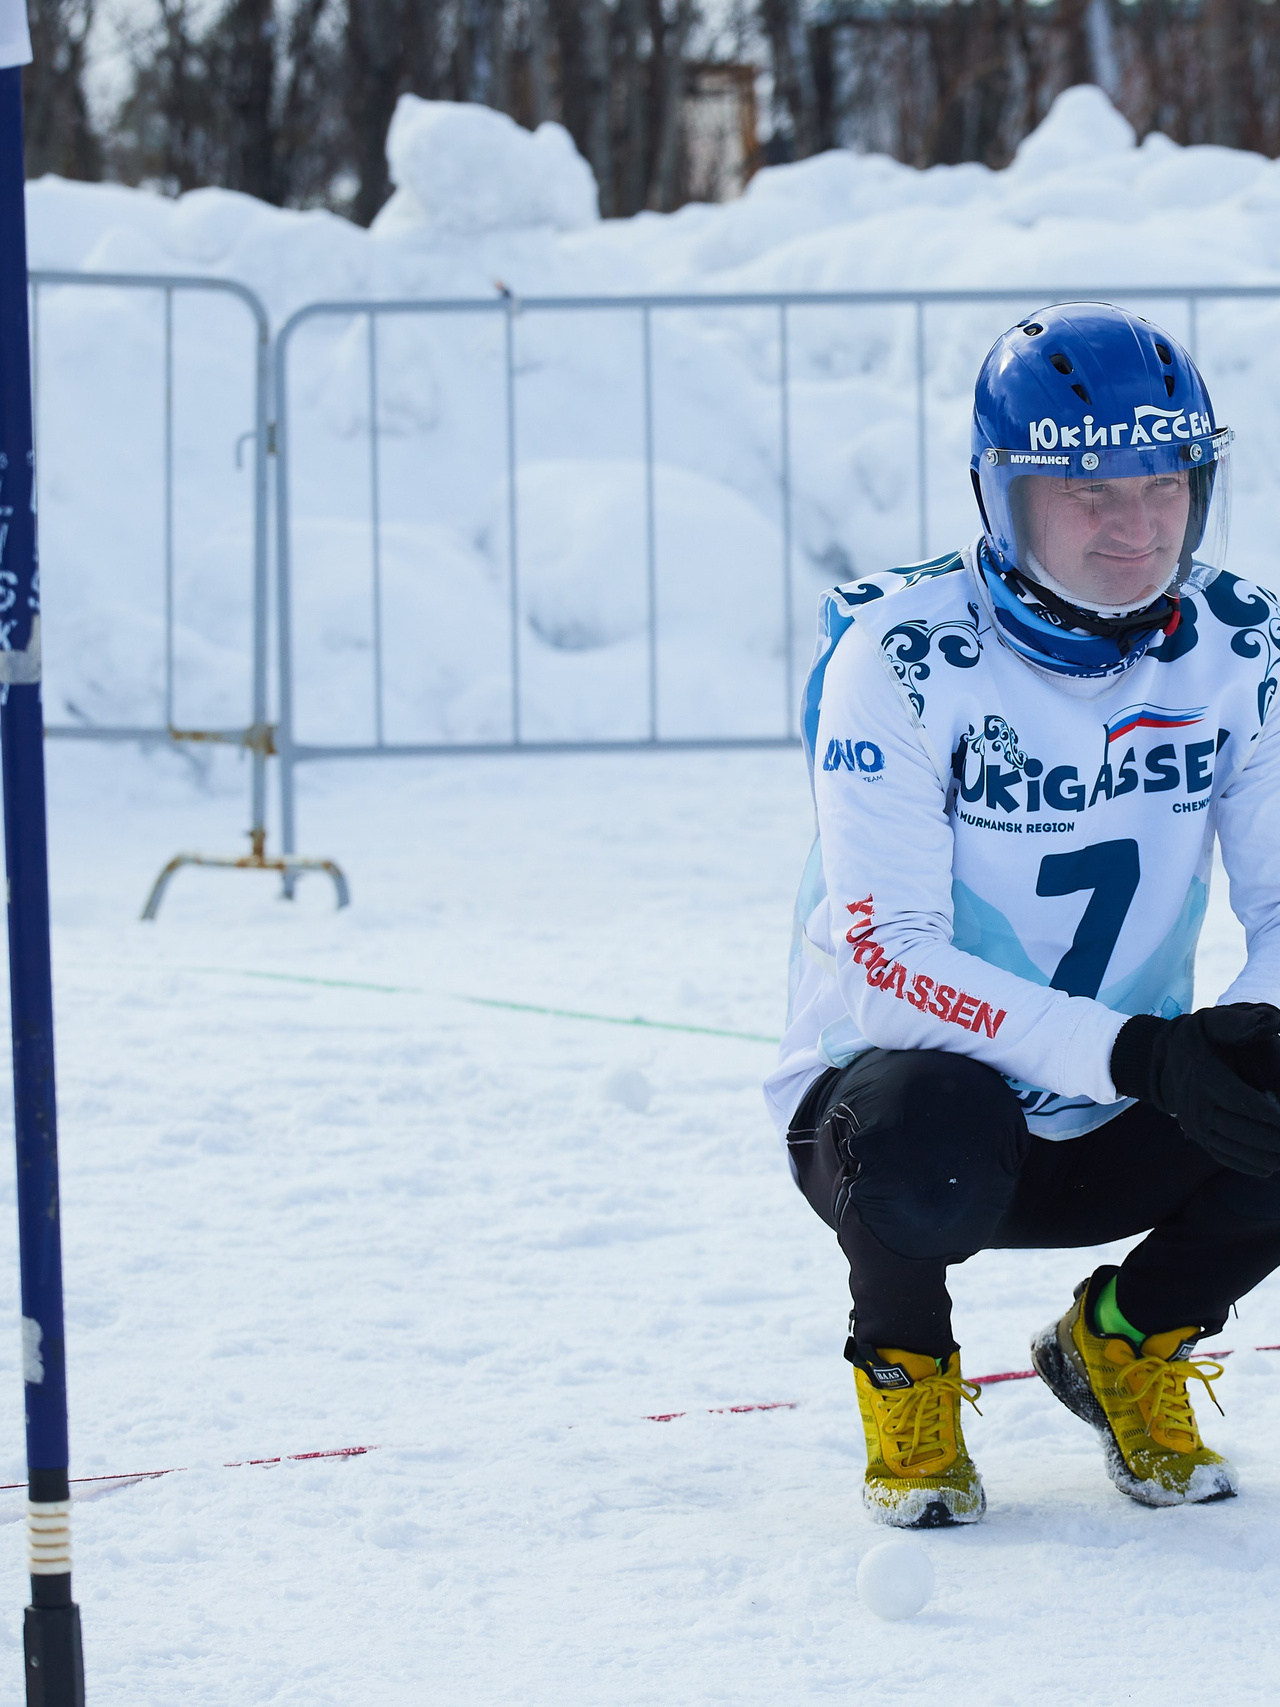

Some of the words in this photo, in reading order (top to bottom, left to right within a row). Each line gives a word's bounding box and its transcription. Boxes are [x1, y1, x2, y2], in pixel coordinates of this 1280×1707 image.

[1010, 454, 1070, 466] МУРМАНСК
[862, 774, 884, 783] TEAM
[959, 810, 1022, 834] MURMANSK
[1026, 822, 1075, 834] REGION
[1035, 840, 1141, 1001] 7
